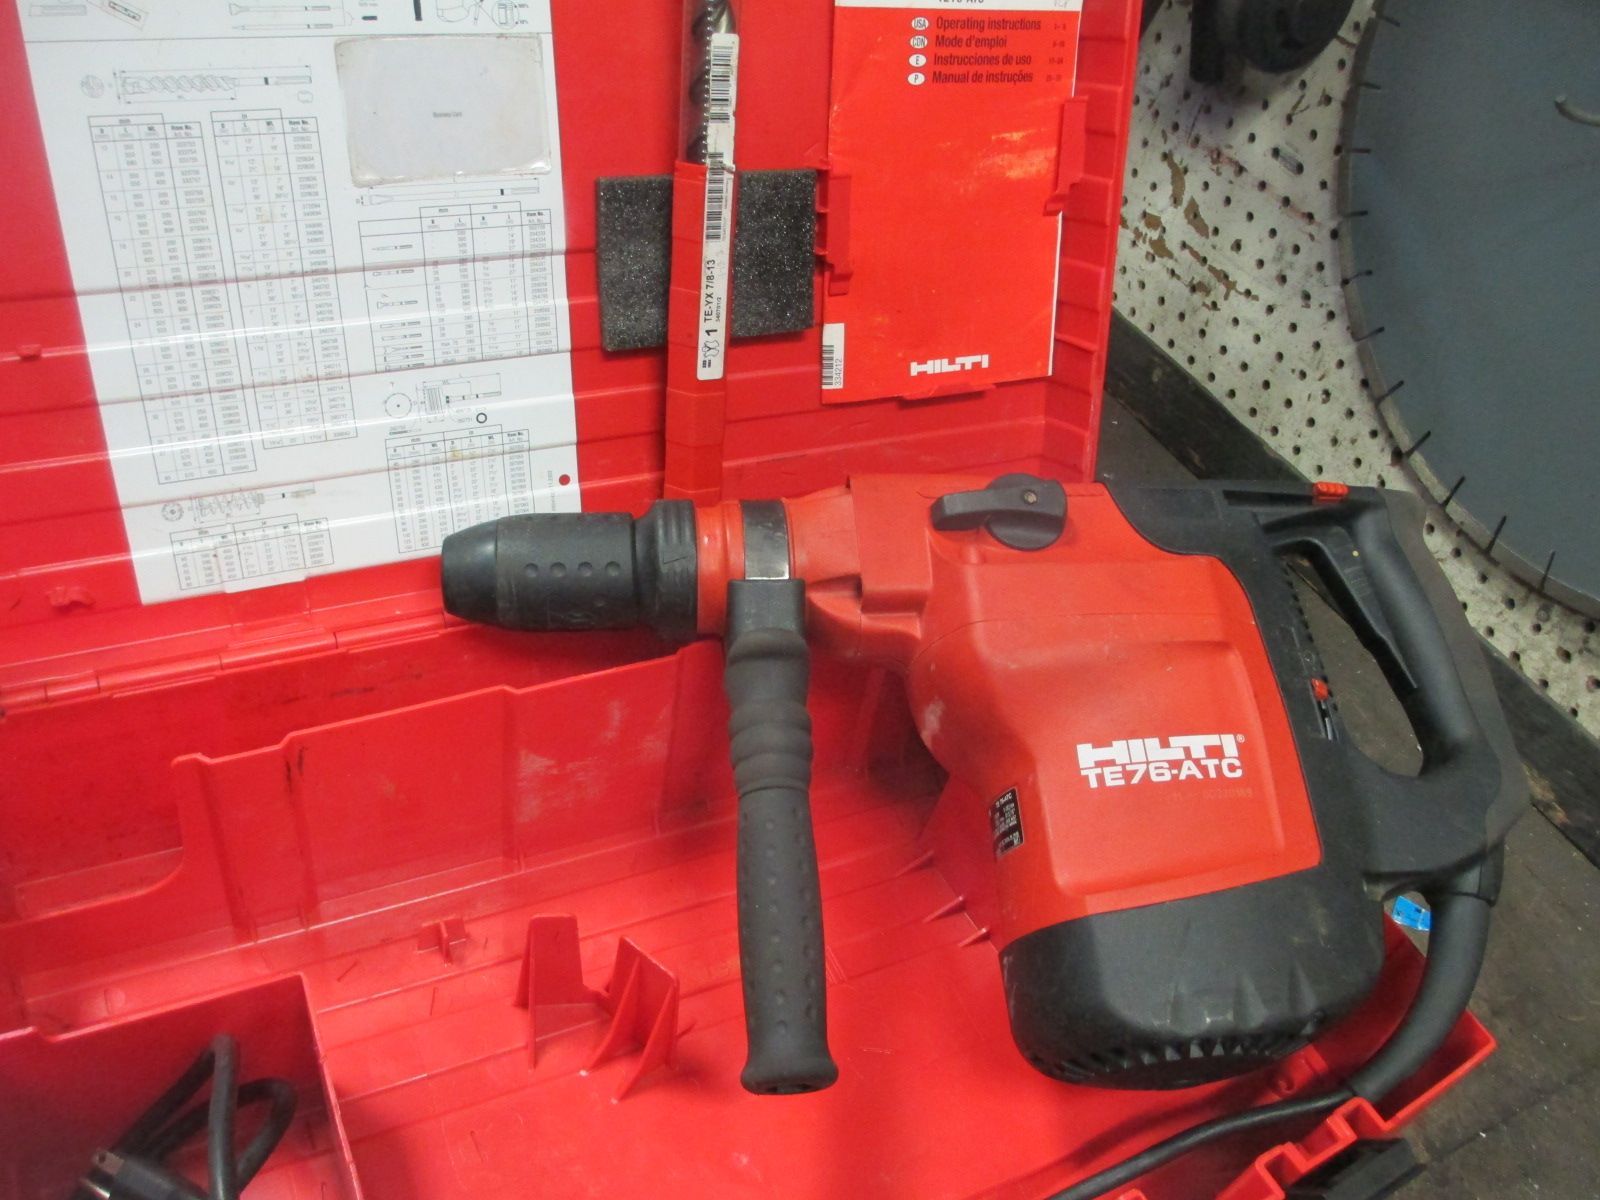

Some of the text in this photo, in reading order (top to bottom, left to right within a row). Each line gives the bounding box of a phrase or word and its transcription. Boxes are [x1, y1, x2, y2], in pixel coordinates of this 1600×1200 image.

[913, 18, 927, 28] USA
[936, 17, 985, 32] Operating
[987, 18, 1041, 31] instructions
[912, 37, 925, 47] CDN
[935, 35, 963, 48] Mode
[965, 35, 1007, 50] d'emploi
[933, 53, 999, 66] Instrucciones
[1002, 54, 1013, 65] de
[1016, 54, 1031, 65] uso
[932, 71, 968, 83] Manual
[971, 71, 982, 83] de
[985, 70, 1033, 85] instruções
[703, 259, 716, 323] TE-YX 7/8-13
[705, 329, 718, 337] 1
[834, 358, 842, 386] 334212
[910, 354, 989, 376] HILTI
[1076, 734, 1239, 768] HILTI
